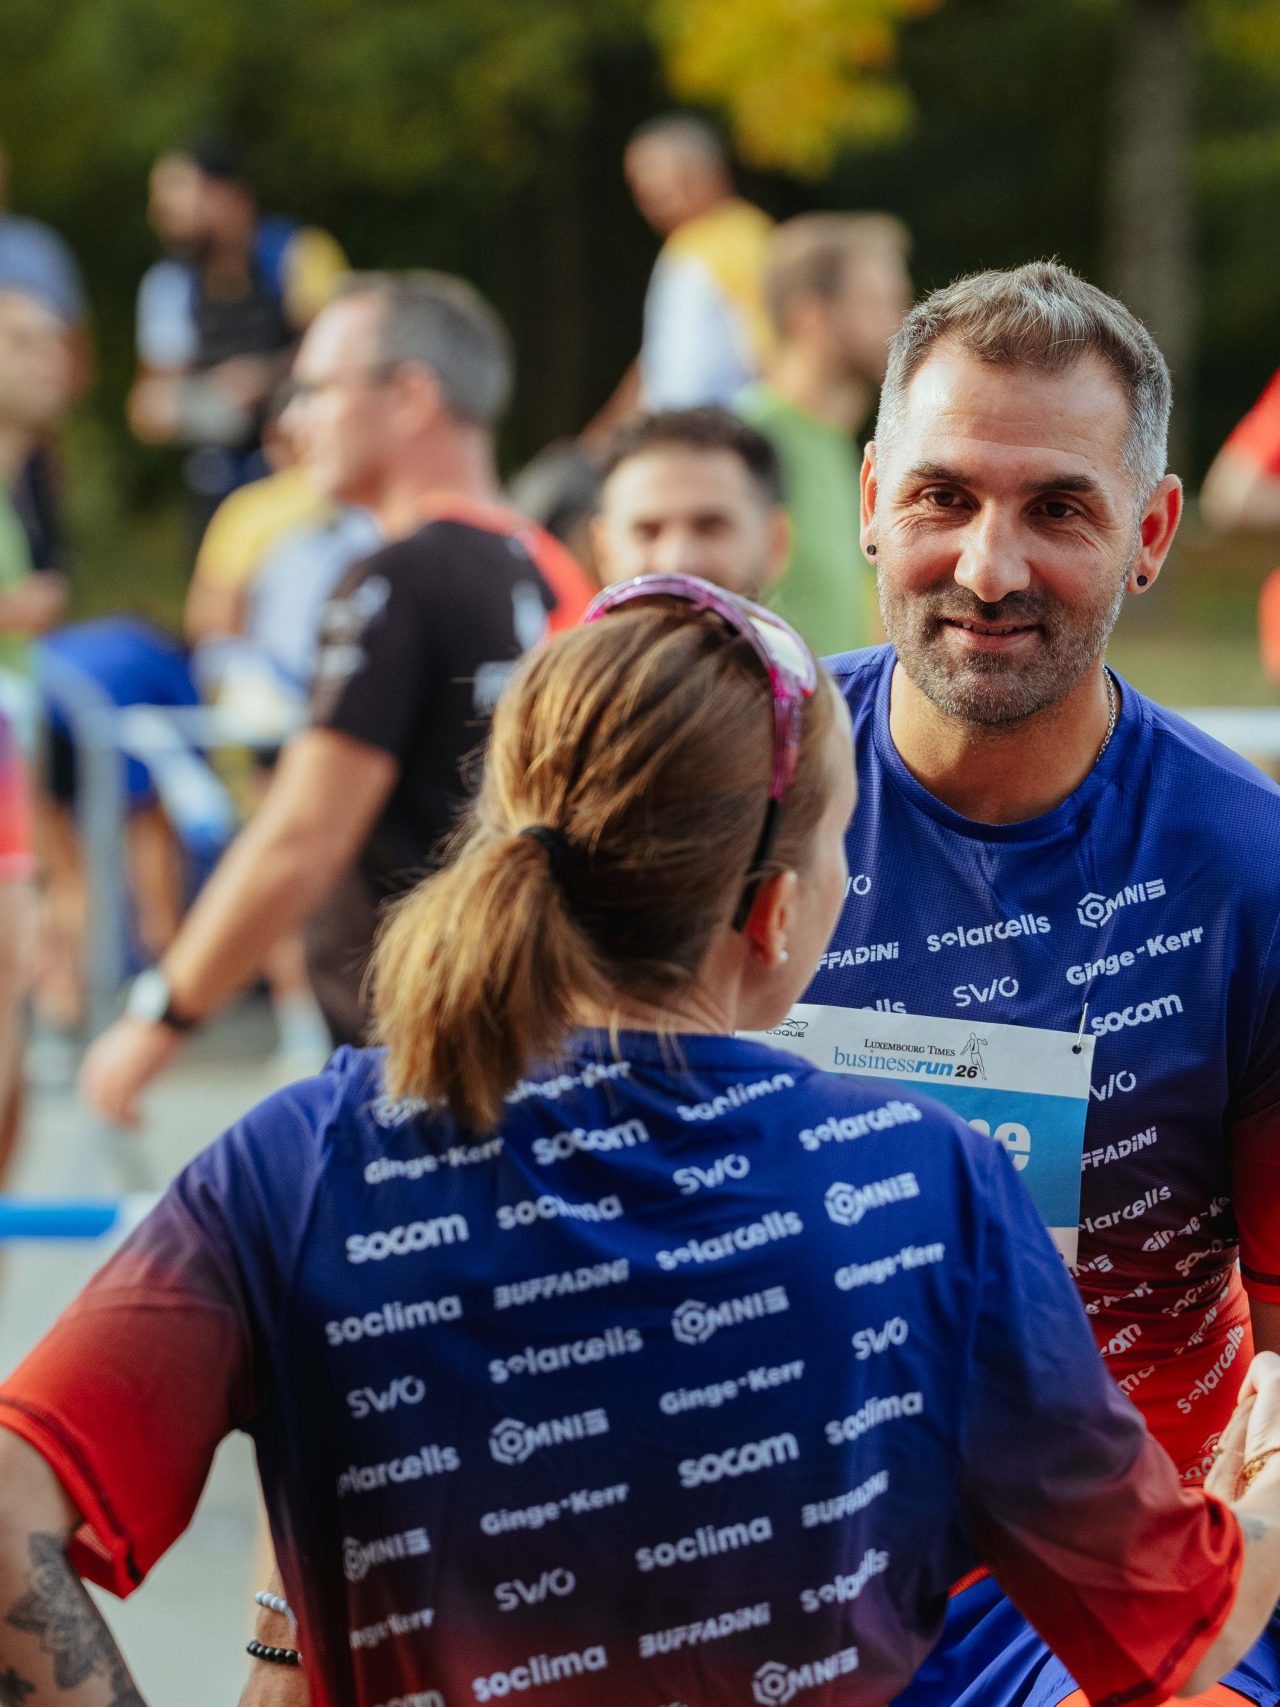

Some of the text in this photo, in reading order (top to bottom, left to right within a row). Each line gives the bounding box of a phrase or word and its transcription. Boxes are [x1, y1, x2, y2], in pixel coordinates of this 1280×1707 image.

[927, 912, 1051, 952] solarcells
[1065, 926, 1204, 986] Ginge-Kerr
[1090, 994, 1184, 1037] socom
[928, 1045, 956, 1057] TIMES
[955, 1065, 978, 1079] 26
[799, 1100, 922, 1151] solarcells
[1078, 1185, 1172, 1233] larcells
[345, 1213, 469, 1264] socom
[655, 1211, 803, 1270] solarcells
[325, 1295, 463, 1346] soclima
[488, 1326, 644, 1384] solarcells
[1176, 1325, 1245, 1414] solarcells
[659, 1360, 805, 1415] Ginge-Kerr
[678, 1432, 799, 1488] socom
[480, 1483, 630, 1536] Ginge-Kerr
[635, 1516, 773, 1572] soclima
[471, 1645, 608, 1702] soclima
